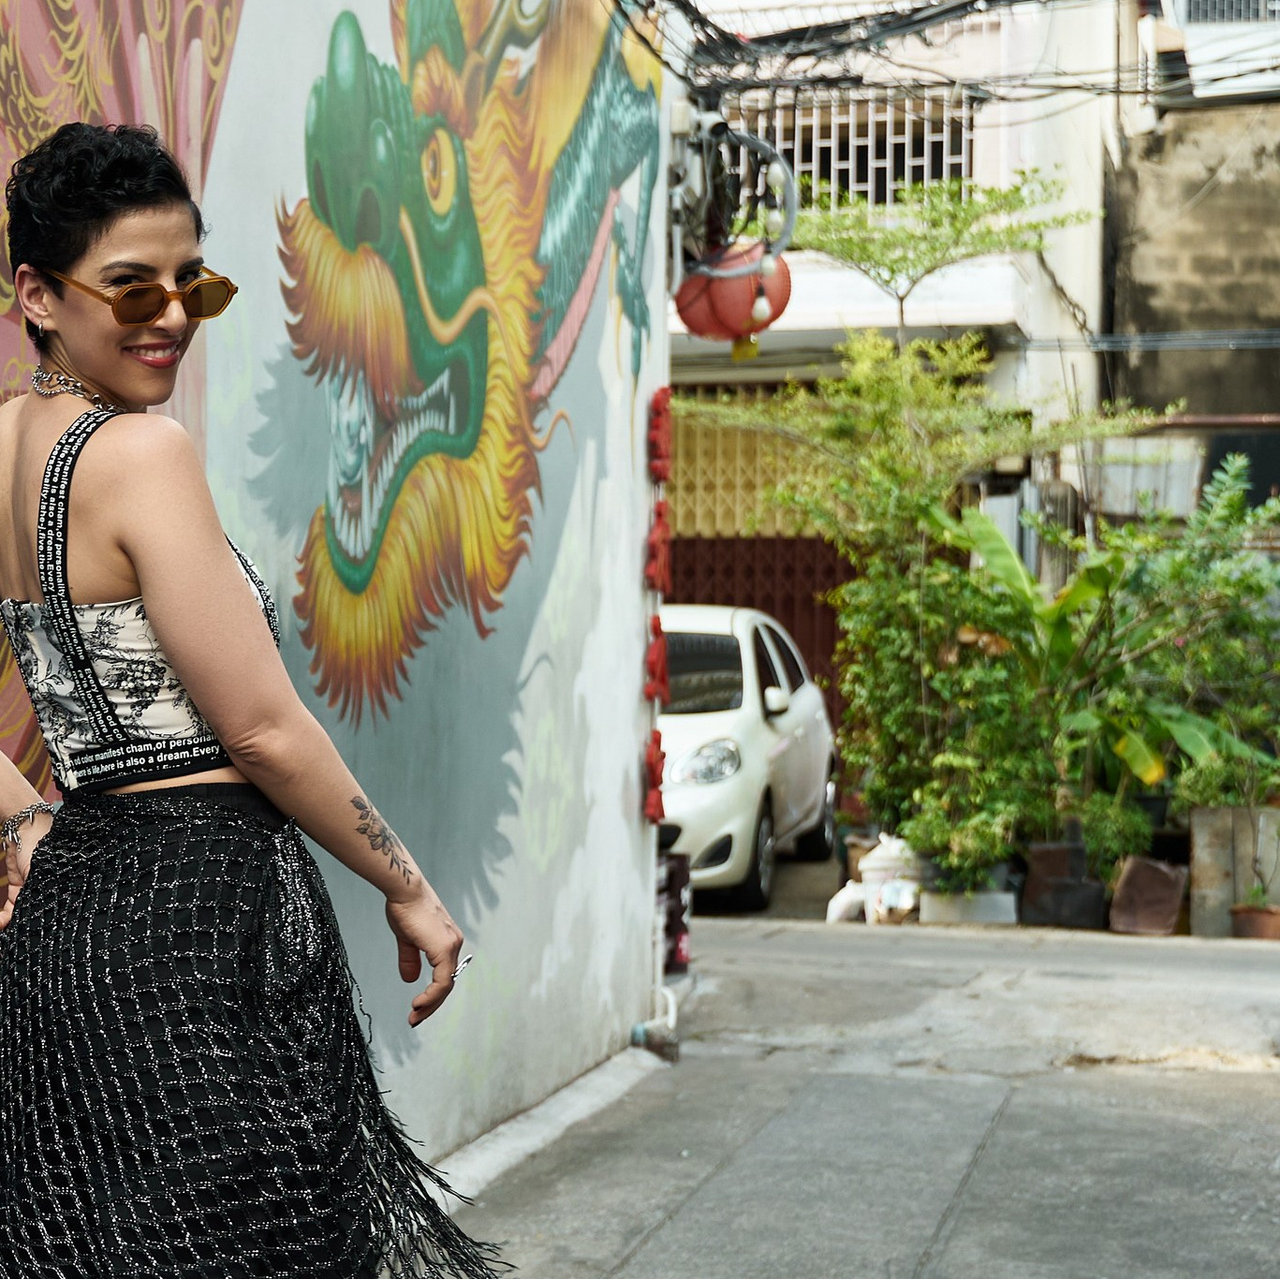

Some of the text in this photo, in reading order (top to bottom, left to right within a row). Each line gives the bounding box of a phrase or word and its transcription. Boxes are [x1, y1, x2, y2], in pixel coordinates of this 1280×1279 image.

[85, 423, 97, 432] od
[70, 433, 87, 455] color
[59, 456, 73, 499] manifest
[51, 485, 58, 494] is
[48, 497, 56, 518] also
[51, 594, 61, 615] inch
[58, 618, 67, 629] od
[63, 632, 75, 655] color
[85, 668, 99, 692] Every
[96, 694, 109, 714] inch
[106, 715, 117, 727] od
[81, 754, 94, 763] color
[95, 747, 125, 761] manifest
[116, 760, 124, 768] is
[126, 757, 145, 766] also
[157, 745, 219, 762] dream.Every
